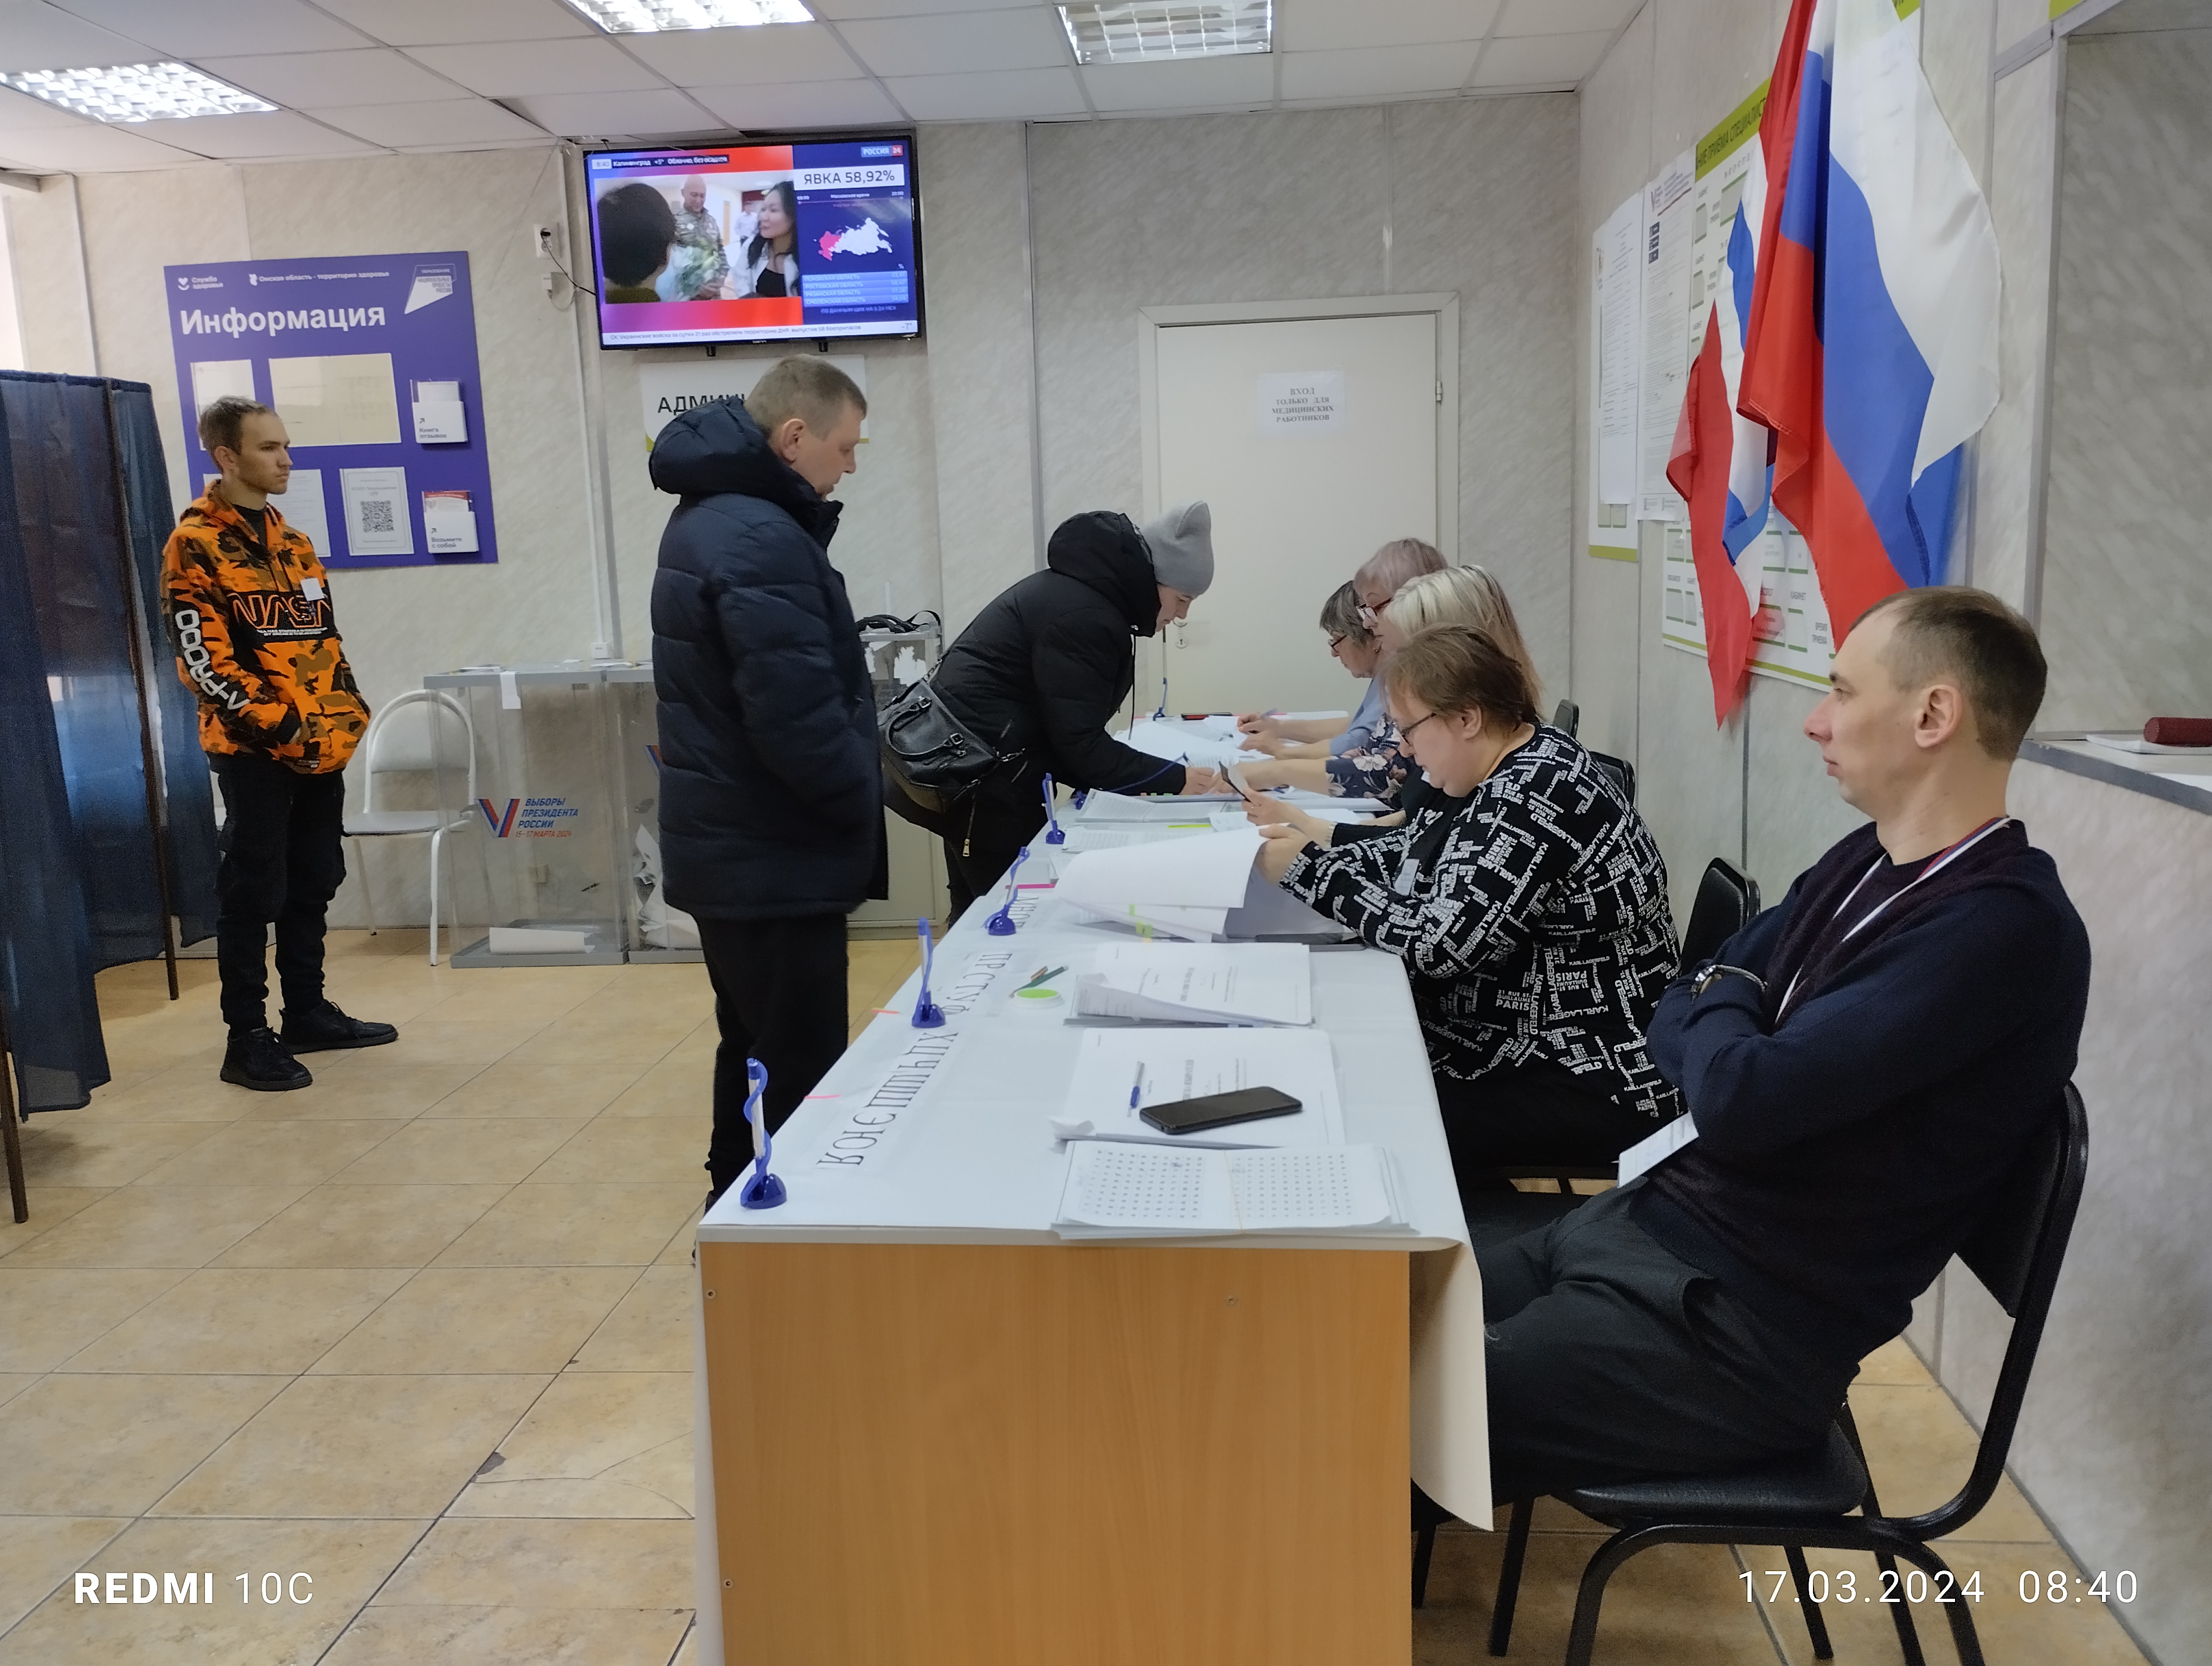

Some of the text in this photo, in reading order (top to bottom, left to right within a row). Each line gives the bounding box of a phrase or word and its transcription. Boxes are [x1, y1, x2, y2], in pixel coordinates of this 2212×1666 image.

[863, 147, 890, 155] РОССИЯ
[803, 170, 895, 185] ЯВКА 58,92%
[181, 306, 385, 338] Информация
[1290, 387, 1315, 395] ВХОД
[1275, 398, 1308, 406] ТОЛЬКО
[1271, 405, 1334, 414] МЕДИЦИНСКИХ
[1276, 414, 1330, 423] РАБОТНИКОВ
[525, 798, 566, 807] ВЫБОРЫ
[521, 809, 578, 818] ПРЕЗИДЕНТА
[518, 820, 555, 829] РОССИИ
[1555, 970, 1587, 979] PARIS
[1495, 999, 1530, 1011] PARIS
[1583, 1004, 1609, 1016] KARL
